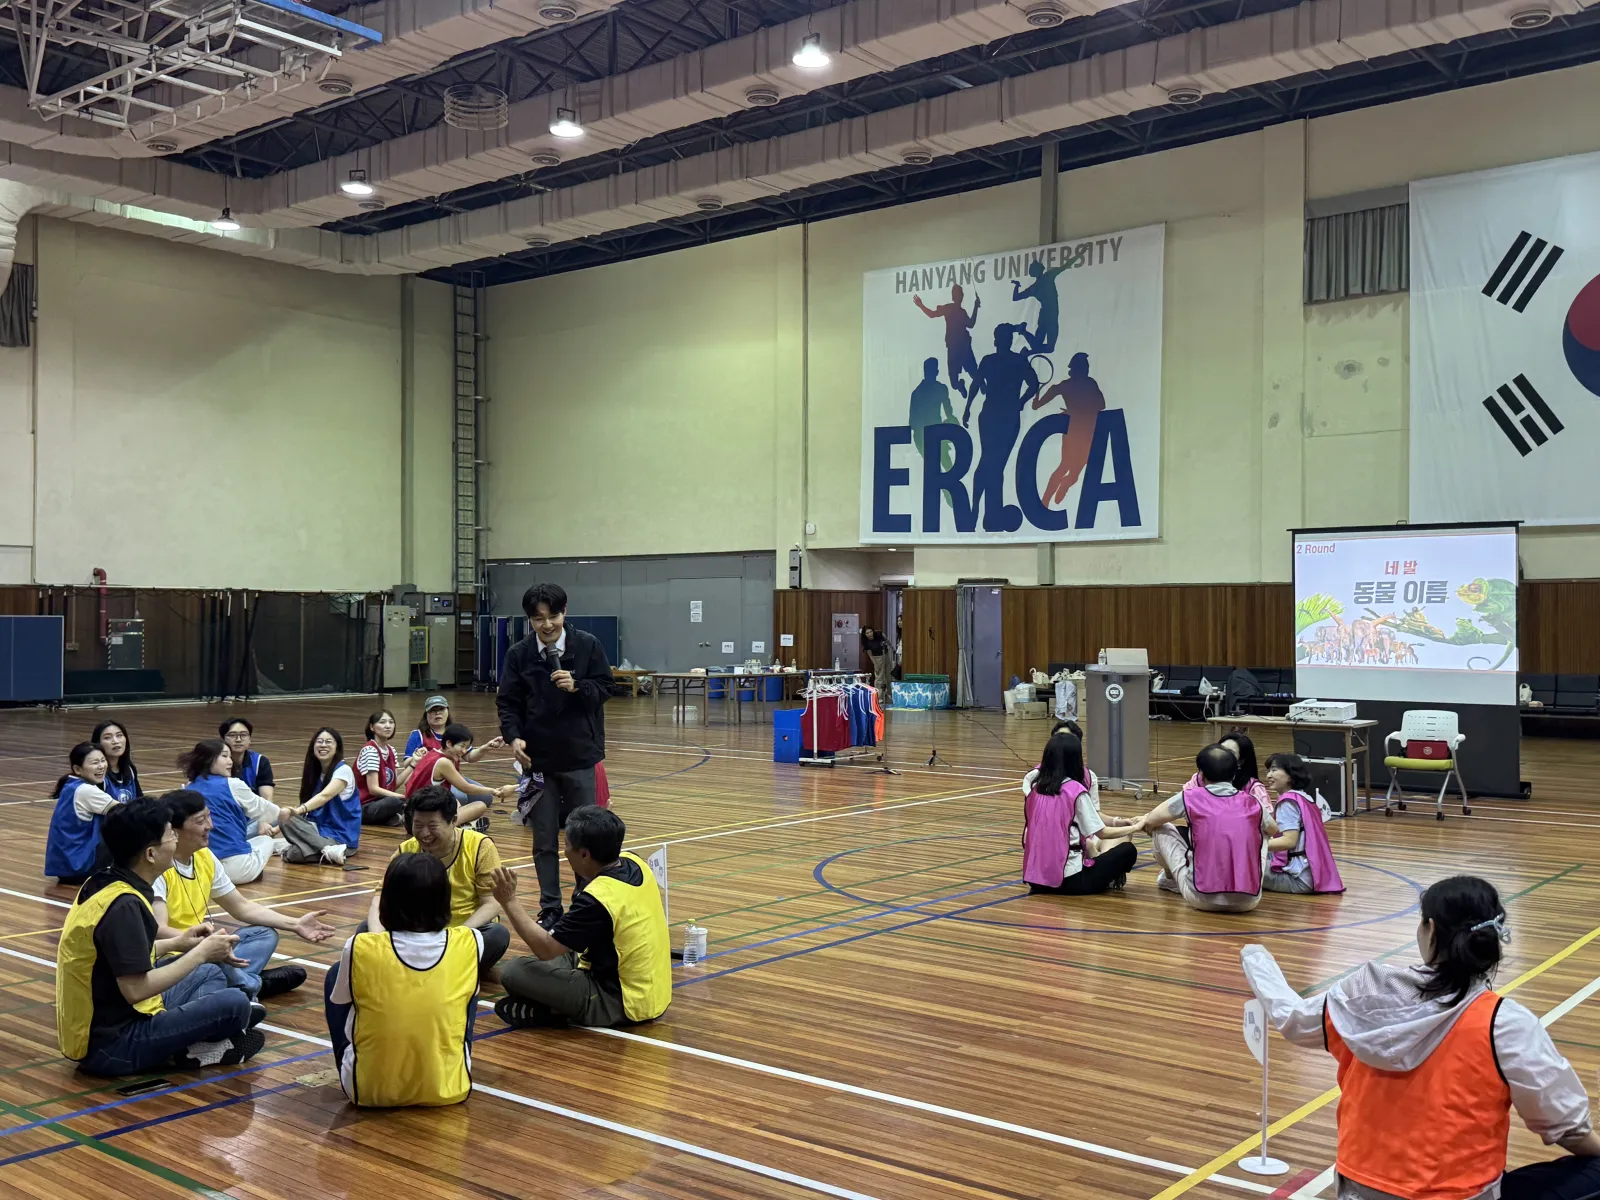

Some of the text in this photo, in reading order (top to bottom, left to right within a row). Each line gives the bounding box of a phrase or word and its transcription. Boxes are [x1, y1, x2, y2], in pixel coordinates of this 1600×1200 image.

[895, 236, 1124, 294] HANYANG UNIVERSITY
[872, 408, 1142, 533] ERICA
[1296, 543, 1336, 554] 2 Round
[1384, 560, 1418, 576] 네 발
[1353, 580, 1448, 605] 동물 이름
